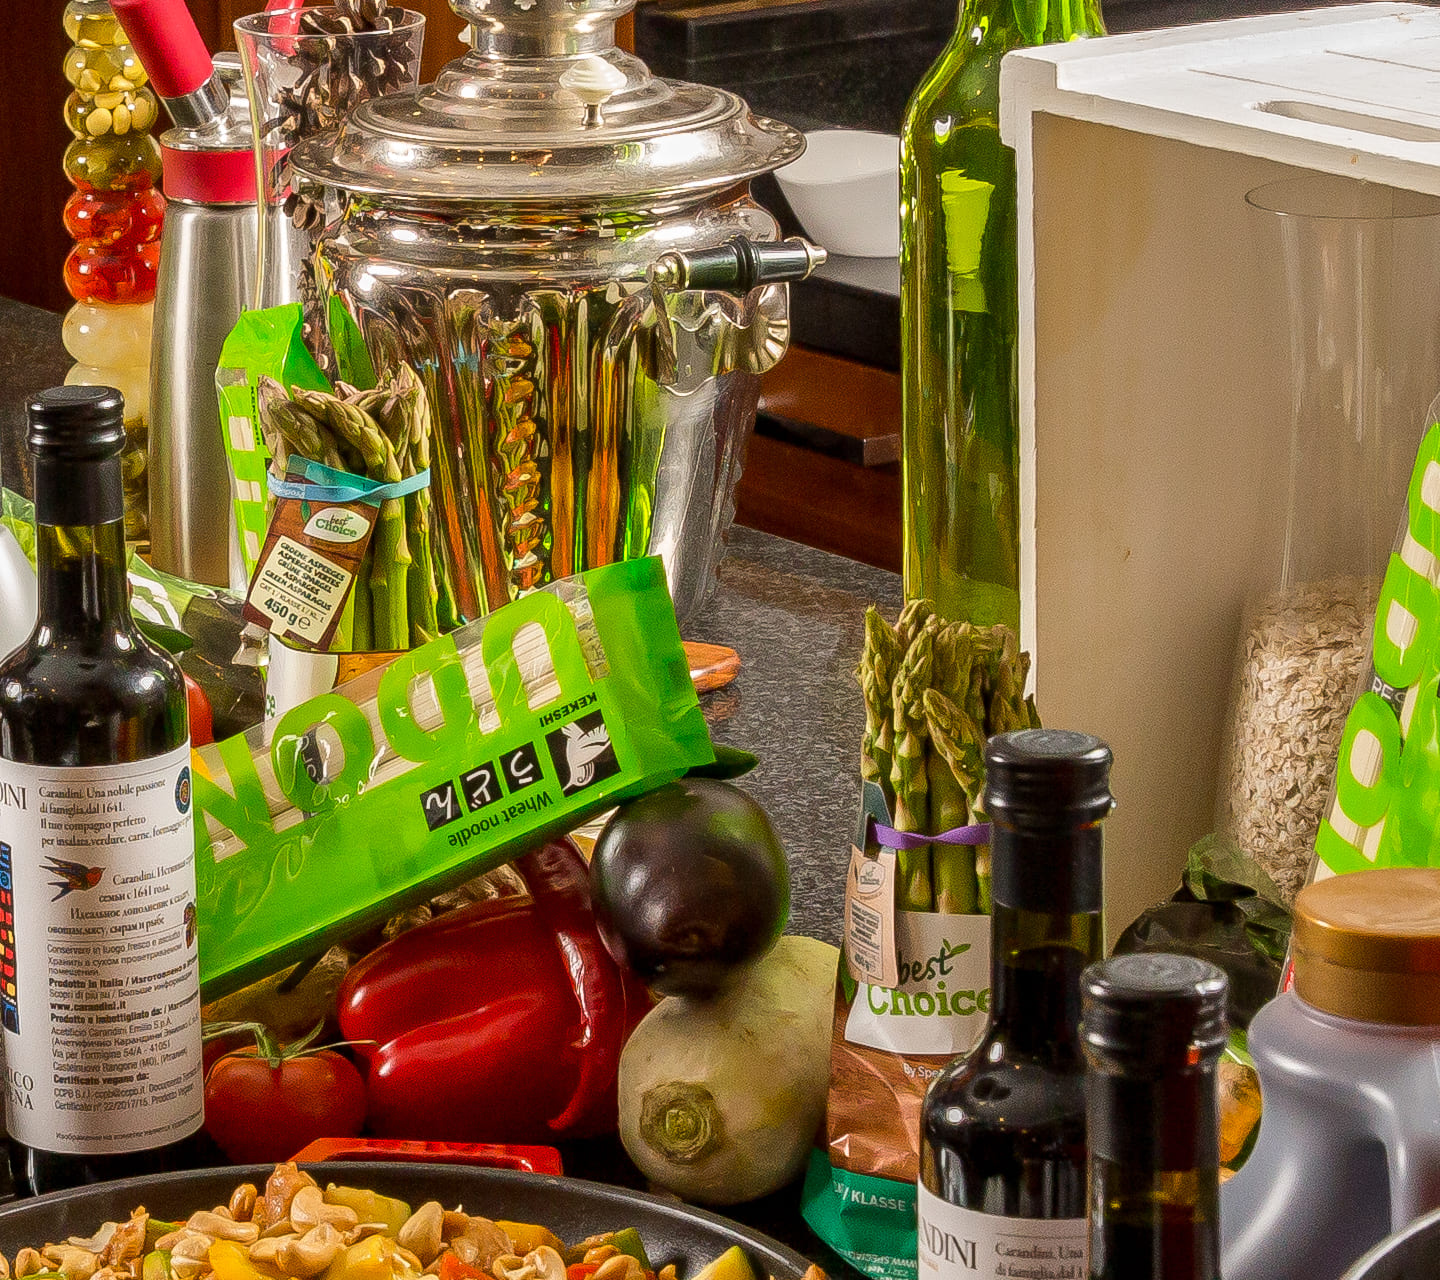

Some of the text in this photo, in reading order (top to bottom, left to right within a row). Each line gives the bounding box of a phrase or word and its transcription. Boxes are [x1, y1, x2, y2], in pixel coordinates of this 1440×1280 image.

[315, 518, 358, 537] Choice
[277, 550, 341, 588] ASPERGES VERTES
[280, 542, 345, 582] GROENE ASPERGES
[278, 559, 332, 594] GRÜNE SPARGEL
[282, 571, 320, 595] ASPARGES
[265, 570, 332, 611] GREEN ASPARAGUS
[264, 597, 298, 626] 450 g
[539, 691, 598, 728] KEKESHI
[38, 779, 166, 799] Carandini. Una nobile passione
[40, 802, 48, 813] di
[64, 818, 111, 833] compagno
[113, 815, 146, 831] perfetto
[447, 792, 555, 848] Wheat noodle
[41, 836, 55, 848] per
[134, 886, 153, 901] 1641
[70, 906, 121, 920] Идеальное
[102, 943, 126, 956] luogo
[93, 956, 119, 967] сухом
[898, 947, 953, 985] best
[49, 978, 86, 989] Prodotto
[89, 978, 97, 988] in
[99, 977, 123, 988] Italia
[50, 1001, 126, 1012] www.carandini.it
[867, 981, 991, 1016] Choice
[51, 1012, 86, 1024] Prodotto
[903, 1063, 917, 1076] By
[53, 1074, 100, 1085] Certificato
[102, 1074, 134, 1086] vegano
[852, 1189, 907, 1212] KLASSE
